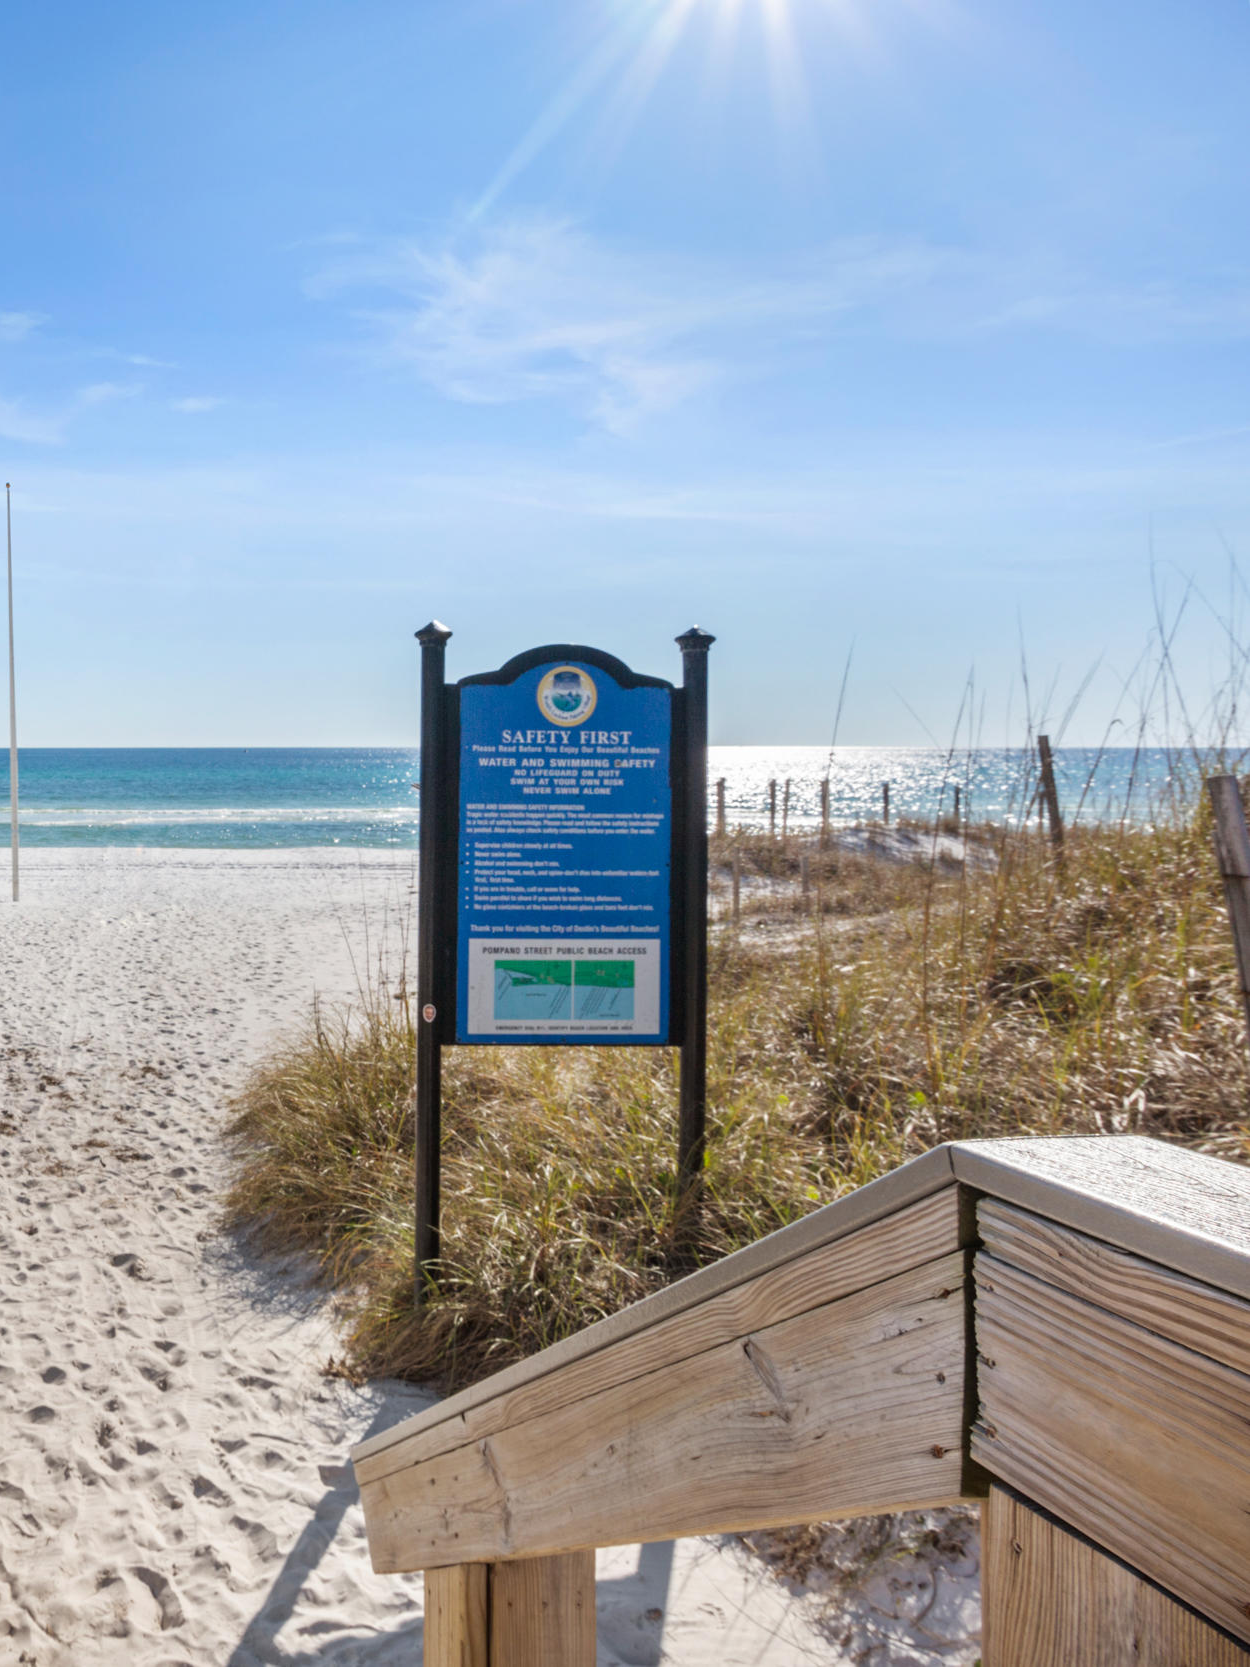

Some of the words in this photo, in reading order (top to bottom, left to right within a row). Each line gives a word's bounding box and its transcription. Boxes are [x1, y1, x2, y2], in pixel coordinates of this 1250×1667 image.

[502, 730, 571, 744] SAFETY
[580, 731, 632, 744] FIRST
[478, 758, 516, 767] WATER
[521, 758, 545, 767] AND
[550, 758, 610, 767] SWIMMING
[614, 759, 656, 768] SAFETY
[471, 924, 491, 932] Thank
[492, 924, 504, 933] you
[505, 924, 515, 933] for
[540, 924, 551, 933] the
[556, 947, 584, 955] PUBLIC
[588, 947, 614, 955] BEACH
[617, 947, 647, 955] ACCESS
